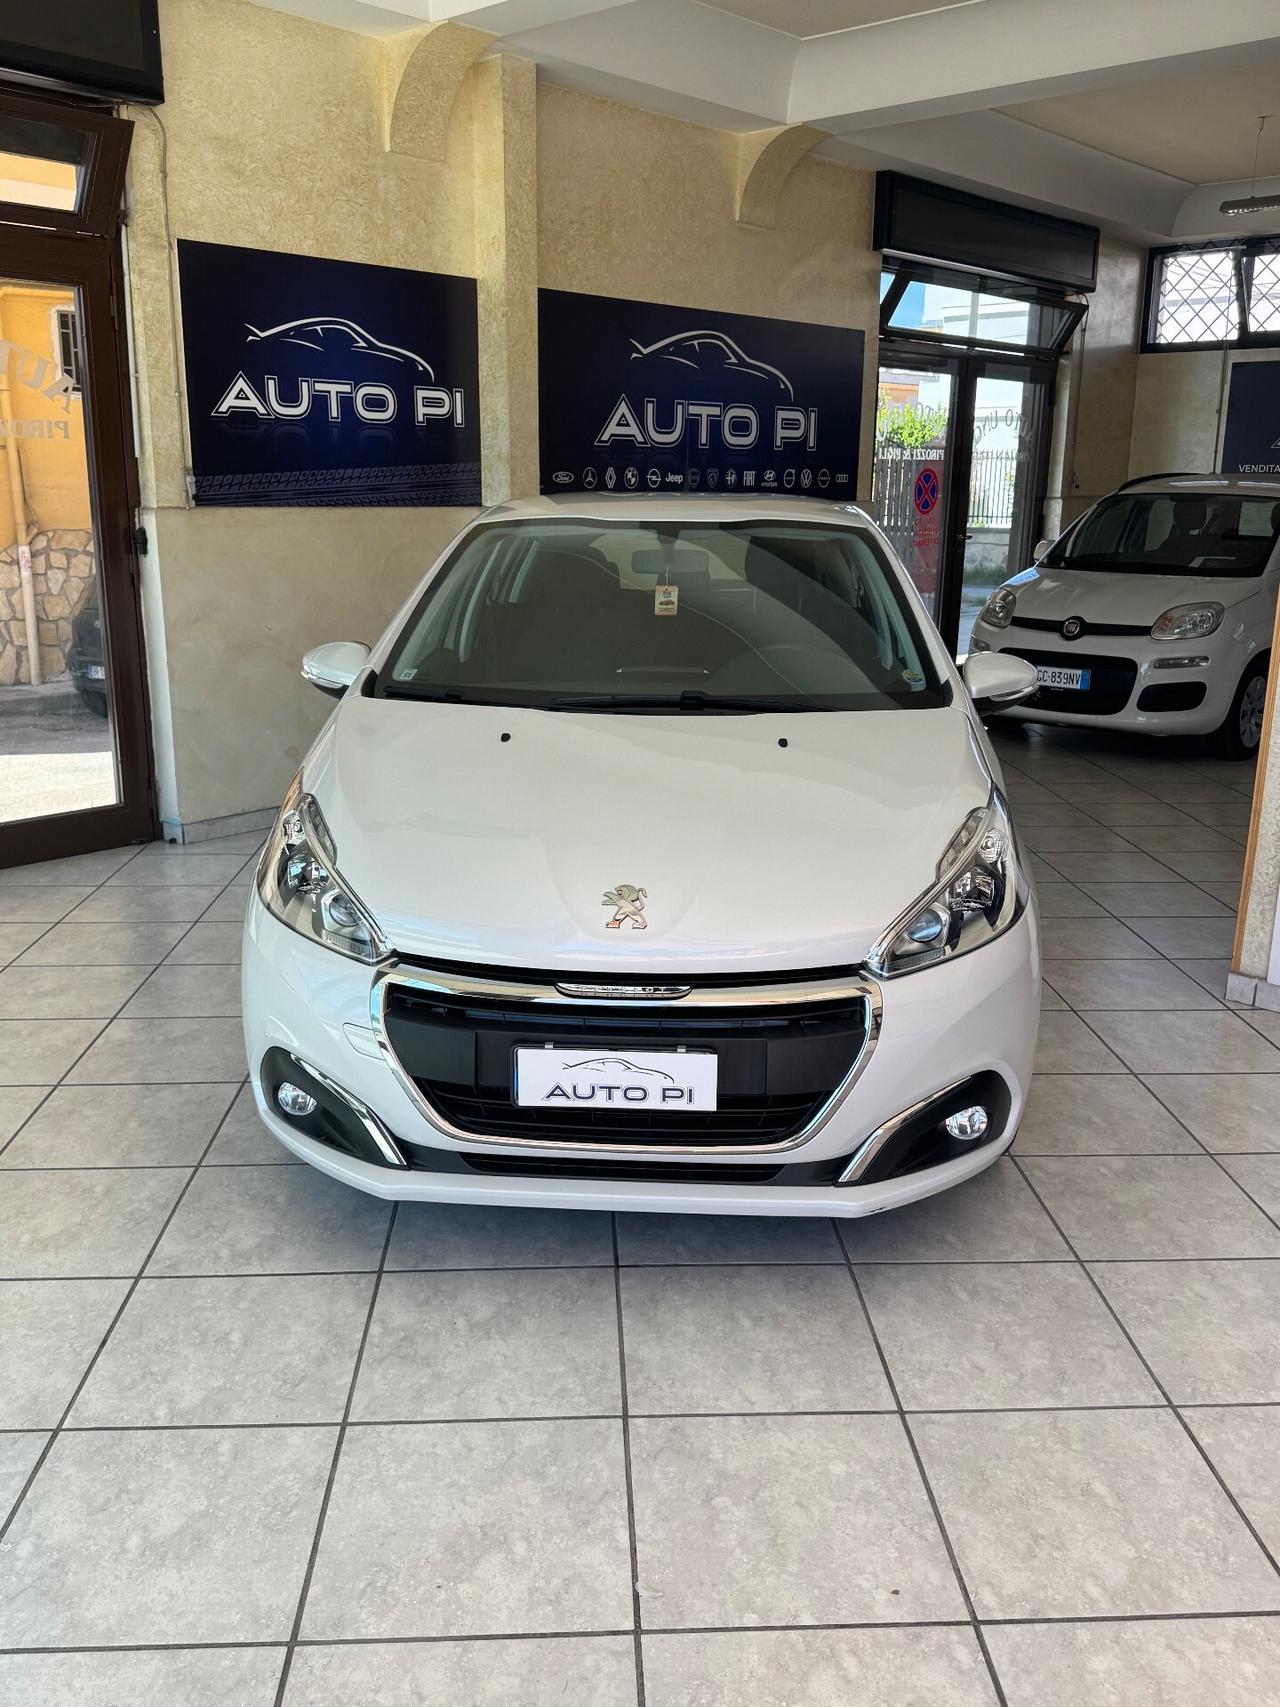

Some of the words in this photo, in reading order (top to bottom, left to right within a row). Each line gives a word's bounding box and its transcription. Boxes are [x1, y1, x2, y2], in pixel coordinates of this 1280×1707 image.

[211, 371, 398, 423] AUTO
[414, 385, 465, 427] PI
[594, 393, 759, 449] AUTO
[774, 406, 818, 451] PI
[666, 473, 683, 484] Jeep
[1239, 464, 1280, 473] VENDITA
[541, 1081, 649, 1102] AUTO
[660, 1086, 695, 1104] PI
